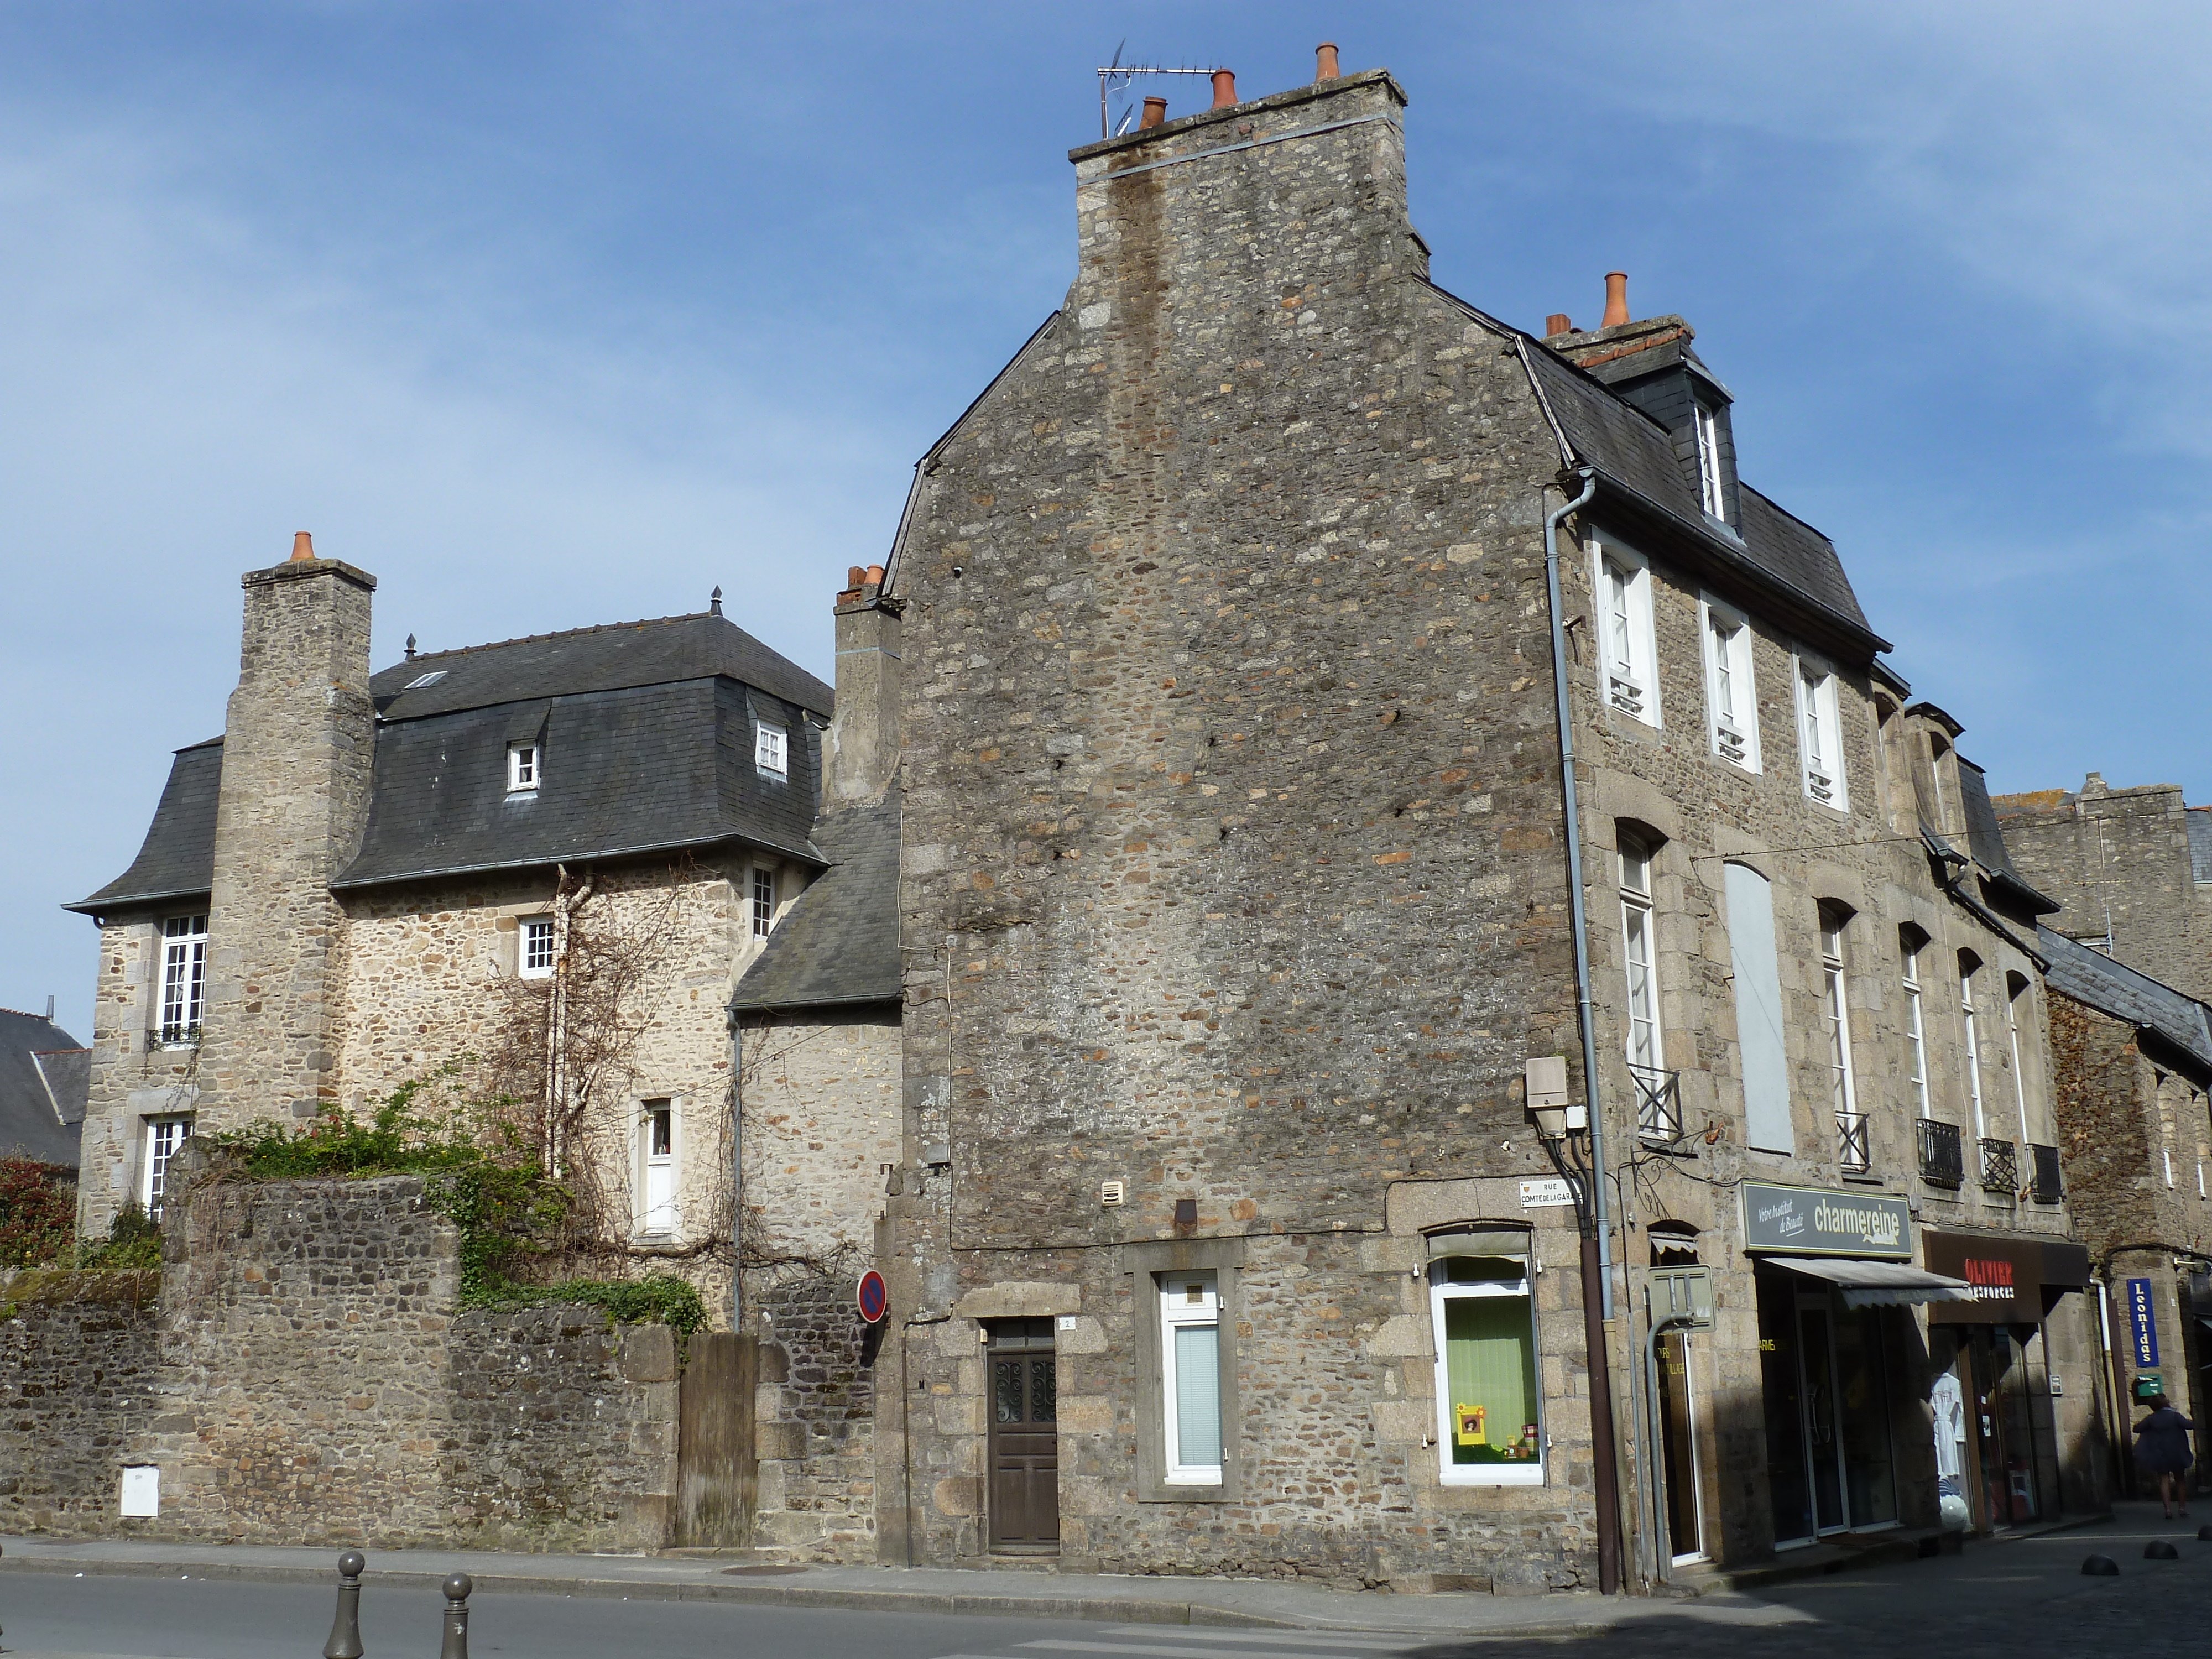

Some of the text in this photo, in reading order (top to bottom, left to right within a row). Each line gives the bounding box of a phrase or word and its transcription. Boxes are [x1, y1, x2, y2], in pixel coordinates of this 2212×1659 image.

[1521, 1194, 1542, 1203] COMTE
[1759, 1199, 1792, 1223] Votre Institut
[1780, 1212, 1804, 1234] de Beauté
[1814, 1198, 1900, 1237] charmereine
[1965, 1258, 2013, 1285] OLIVIER
[2135, 1283, 2151, 1362] Leonidas
